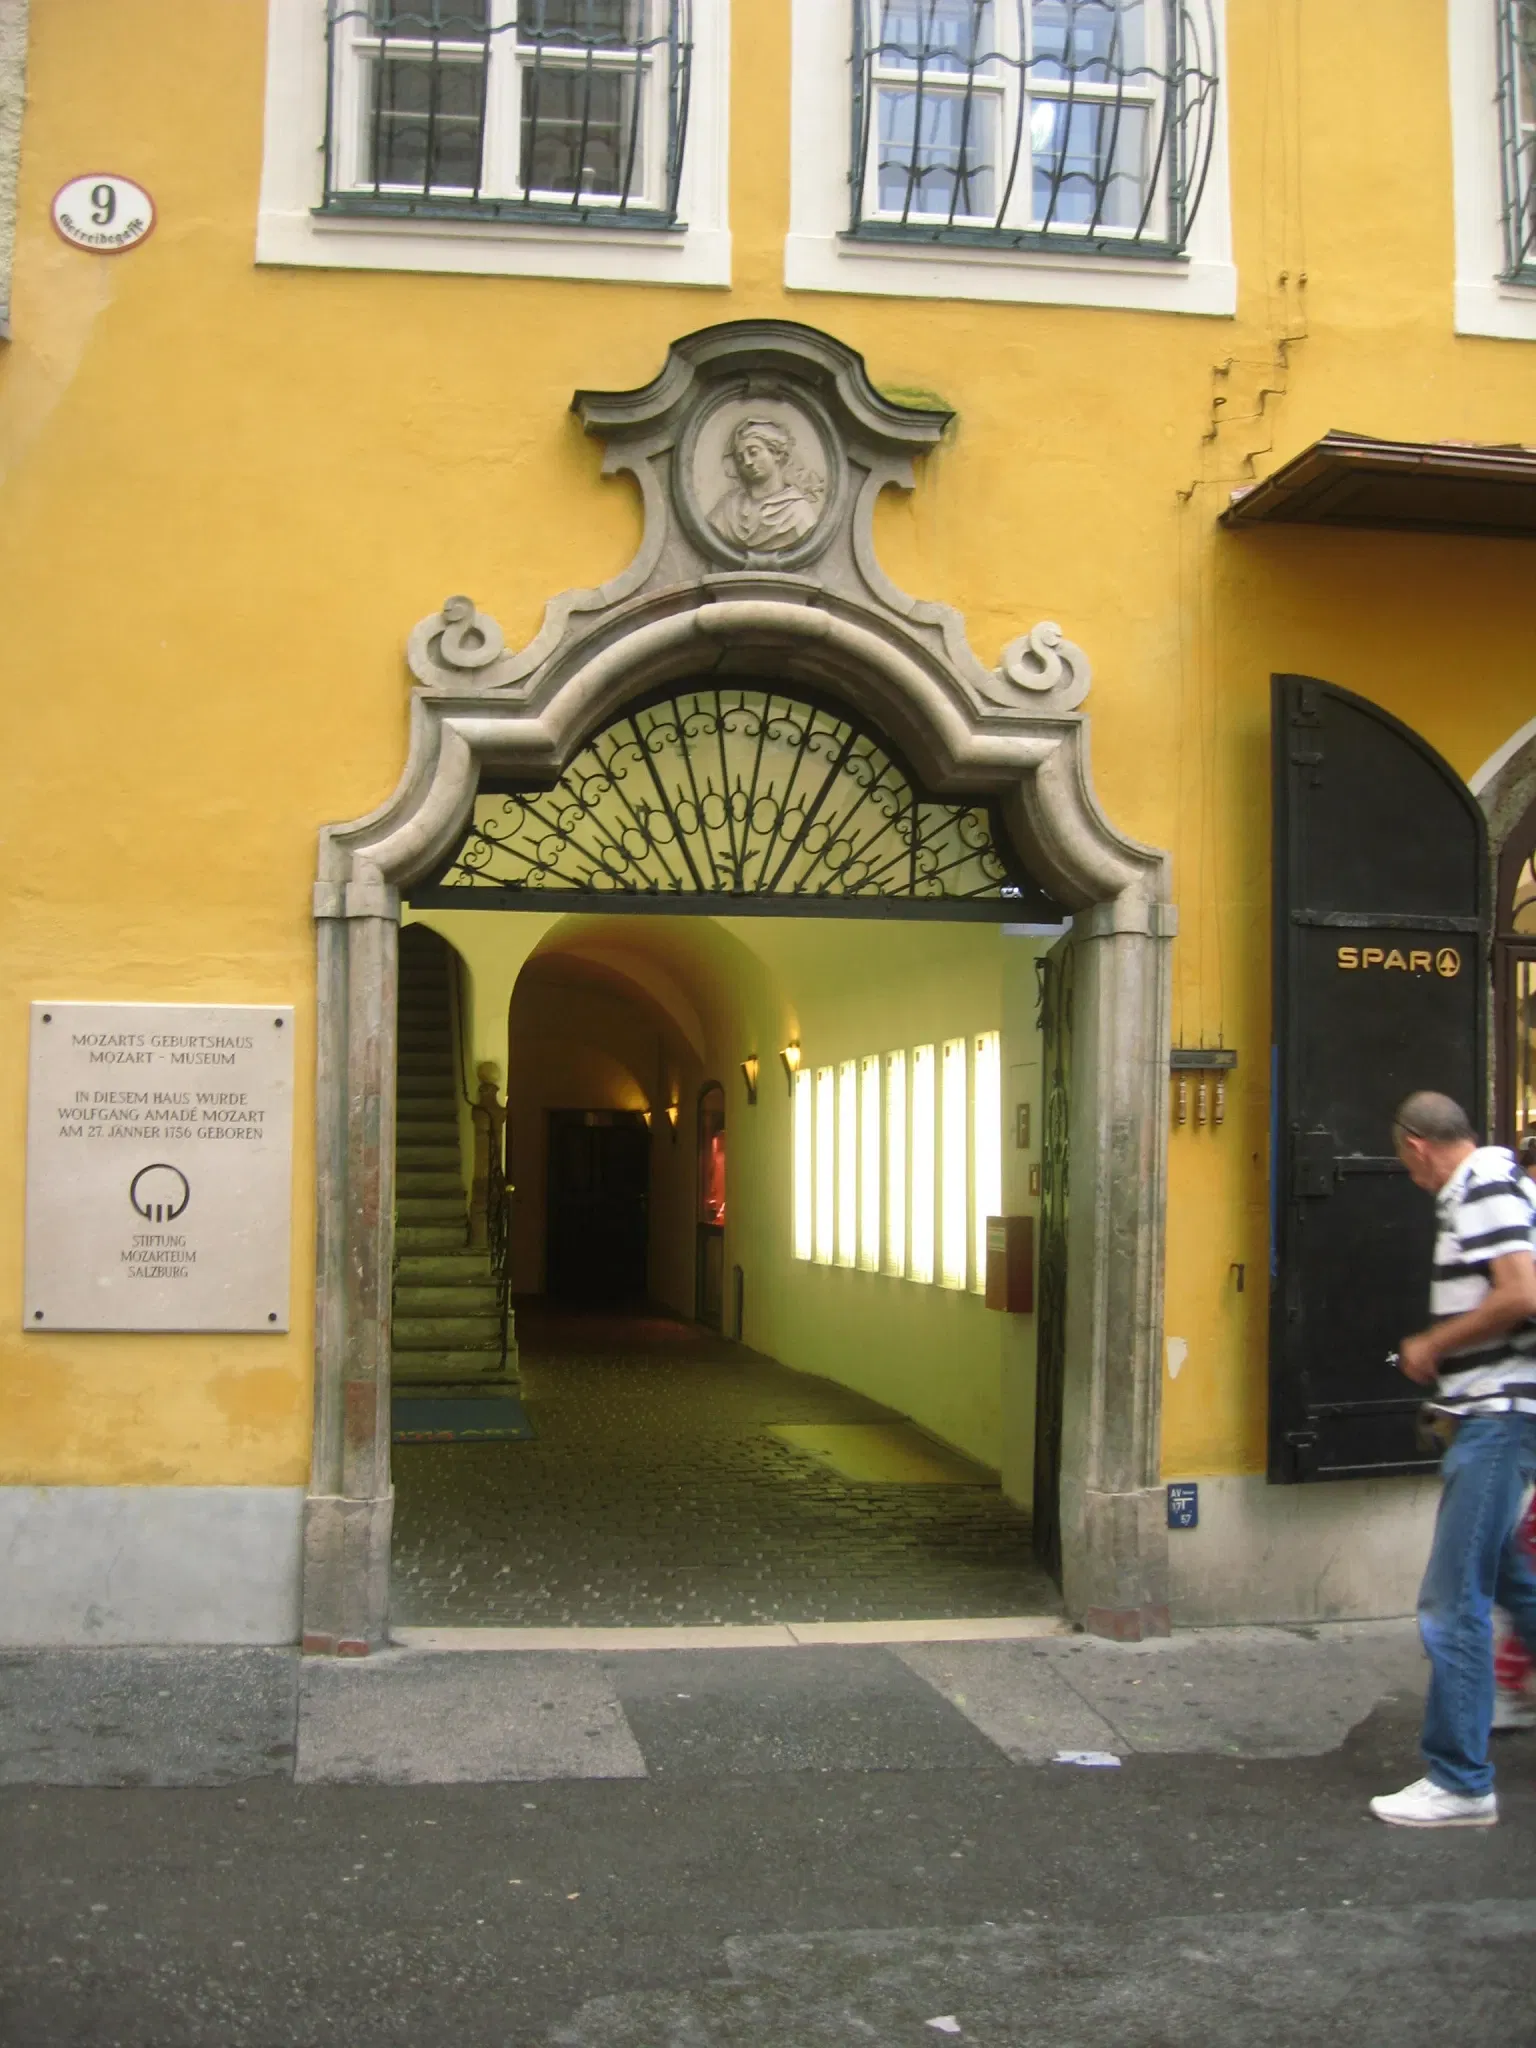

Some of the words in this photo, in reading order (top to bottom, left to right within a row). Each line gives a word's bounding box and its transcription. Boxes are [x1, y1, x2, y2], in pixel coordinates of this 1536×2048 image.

[91, 184, 116, 225] 9
[1337, 946, 1432, 972] SPAR
[72, 1034, 145, 1047] MOZARTS
[150, 1035, 253, 1049] GEBURTSHAUS
[89, 1051, 153, 1064] MOZART
[170, 1052, 236, 1065] MUSEUM
[75, 1090, 89, 1103] IN
[94, 1091, 148, 1104] DIESEM
[153, 1092, 190, 1105] HAUS
[196, 1092, 248, 1106] WURDE
[58, 1107, 139, 1121] WOLFGANG
[144, 1106, 198, 1122] AMADÉ
[202, 1110, 265, 1122] MOZART
[59, 1126, 83, 1138] AM
[164, 1127, 192, 1139] 1756
[197, 1127, 263, 1140] GEBOREN
[132, 1235, 186, 1248] STIFTUNG
[121, 1250, 196, 1263] MOZARTEUM
[128, 1266, 188, 1278] SALZBURG
